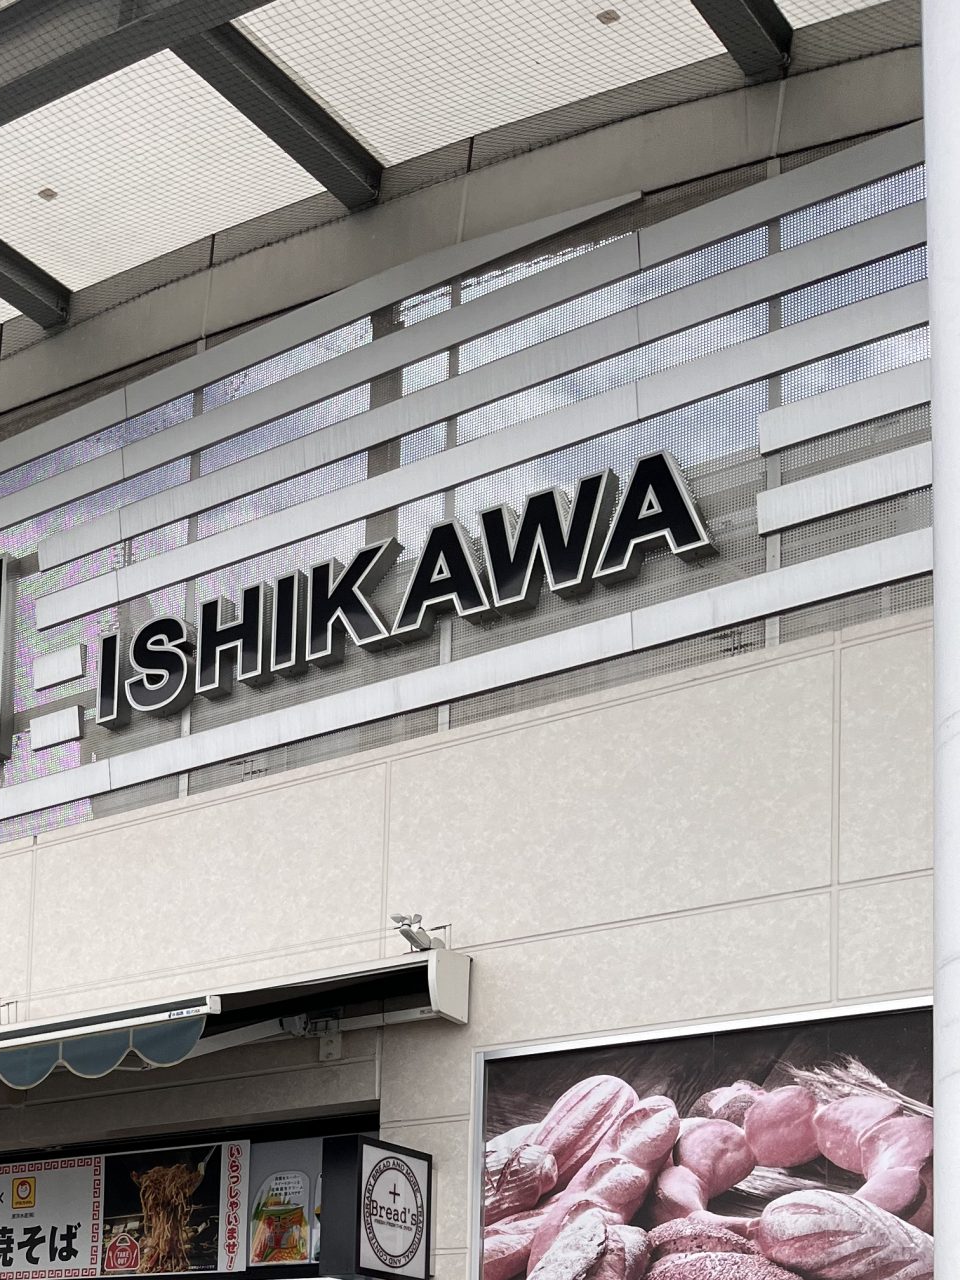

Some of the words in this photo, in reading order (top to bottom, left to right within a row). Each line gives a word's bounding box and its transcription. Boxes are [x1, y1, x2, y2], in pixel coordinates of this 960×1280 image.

[94, 450, 715, 733] ISHIKAWA
[372, 1160, 391, 1181] BREAD
[392, 1159, 405, 1172] AND
[370, 1199, 417, 1226] Bread's
